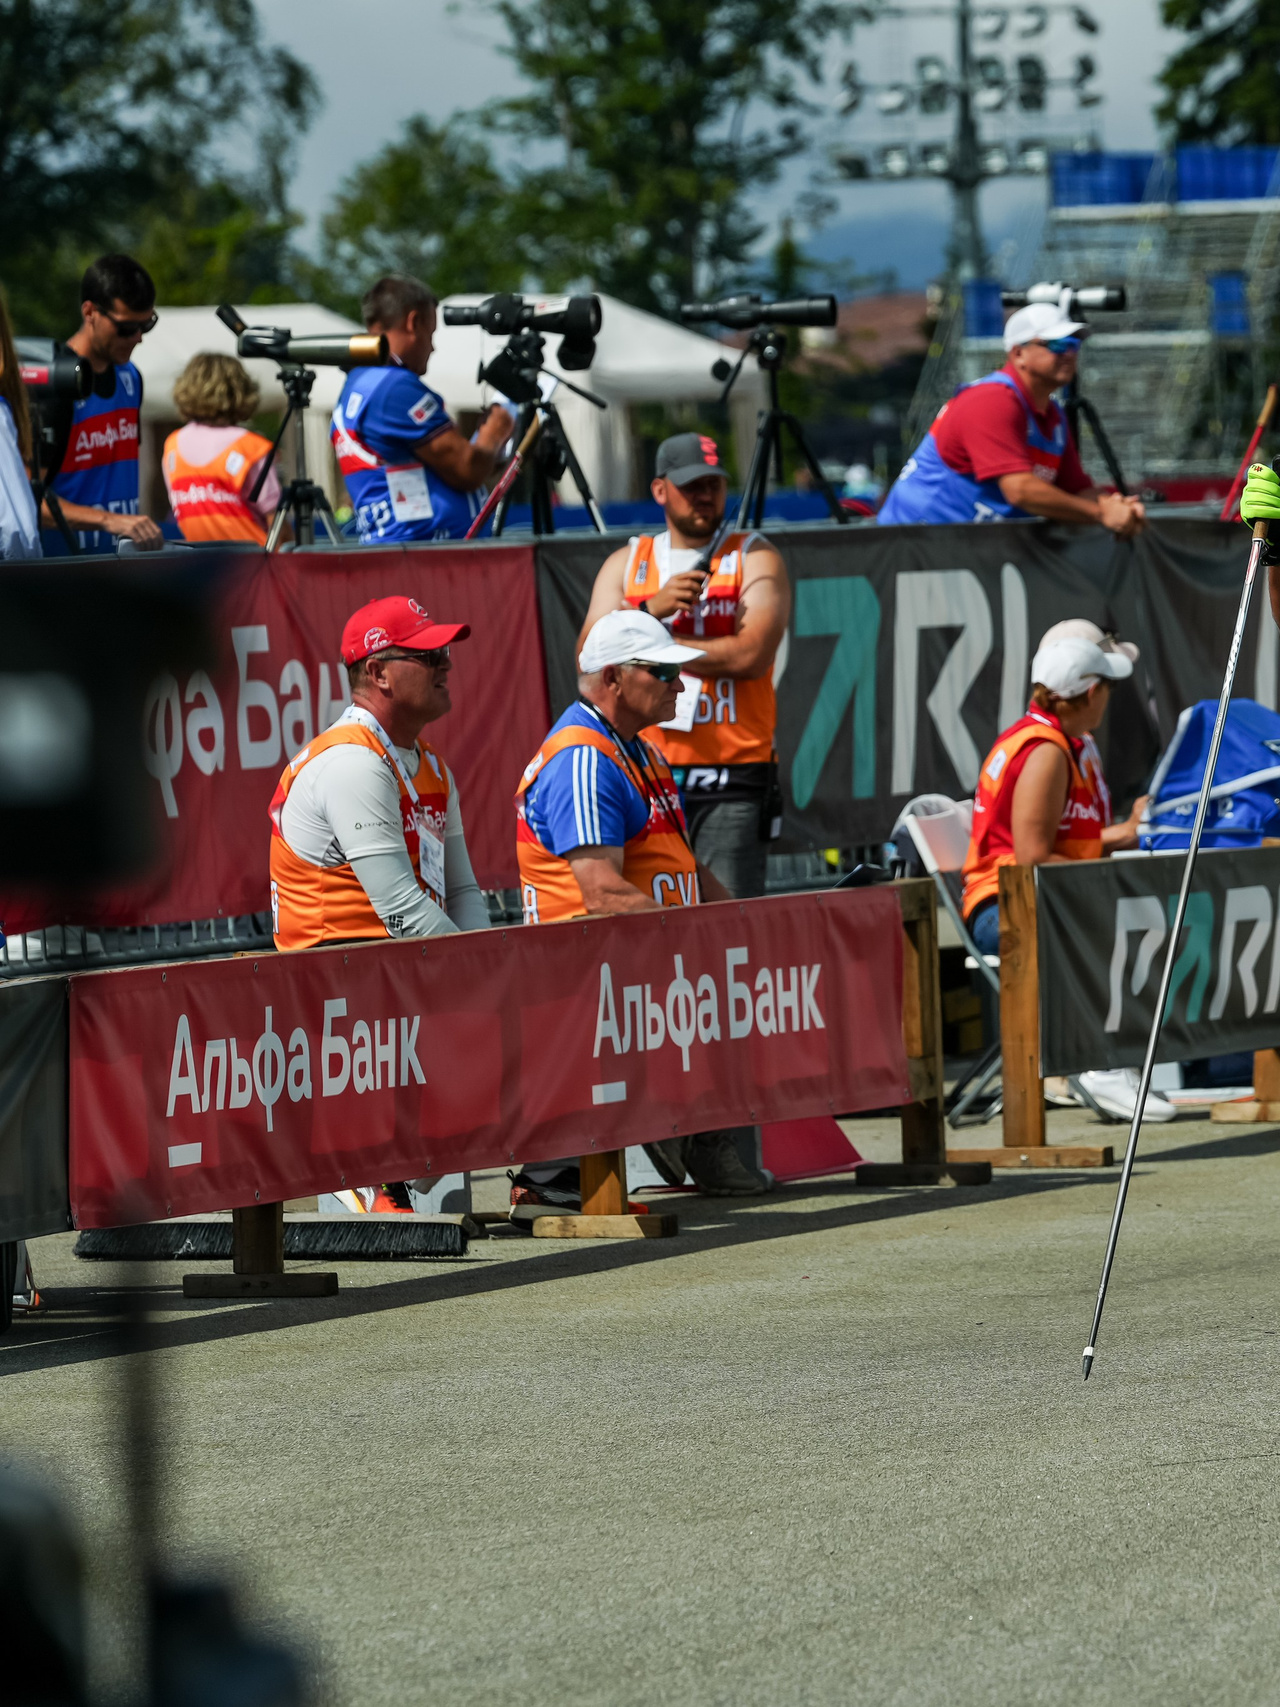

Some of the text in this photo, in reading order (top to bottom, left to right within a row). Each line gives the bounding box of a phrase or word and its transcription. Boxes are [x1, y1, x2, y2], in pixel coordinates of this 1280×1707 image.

[166, 997, 427, 1132] Альфа Банк
[593, 946, 826, 1072] Альфа Банк
